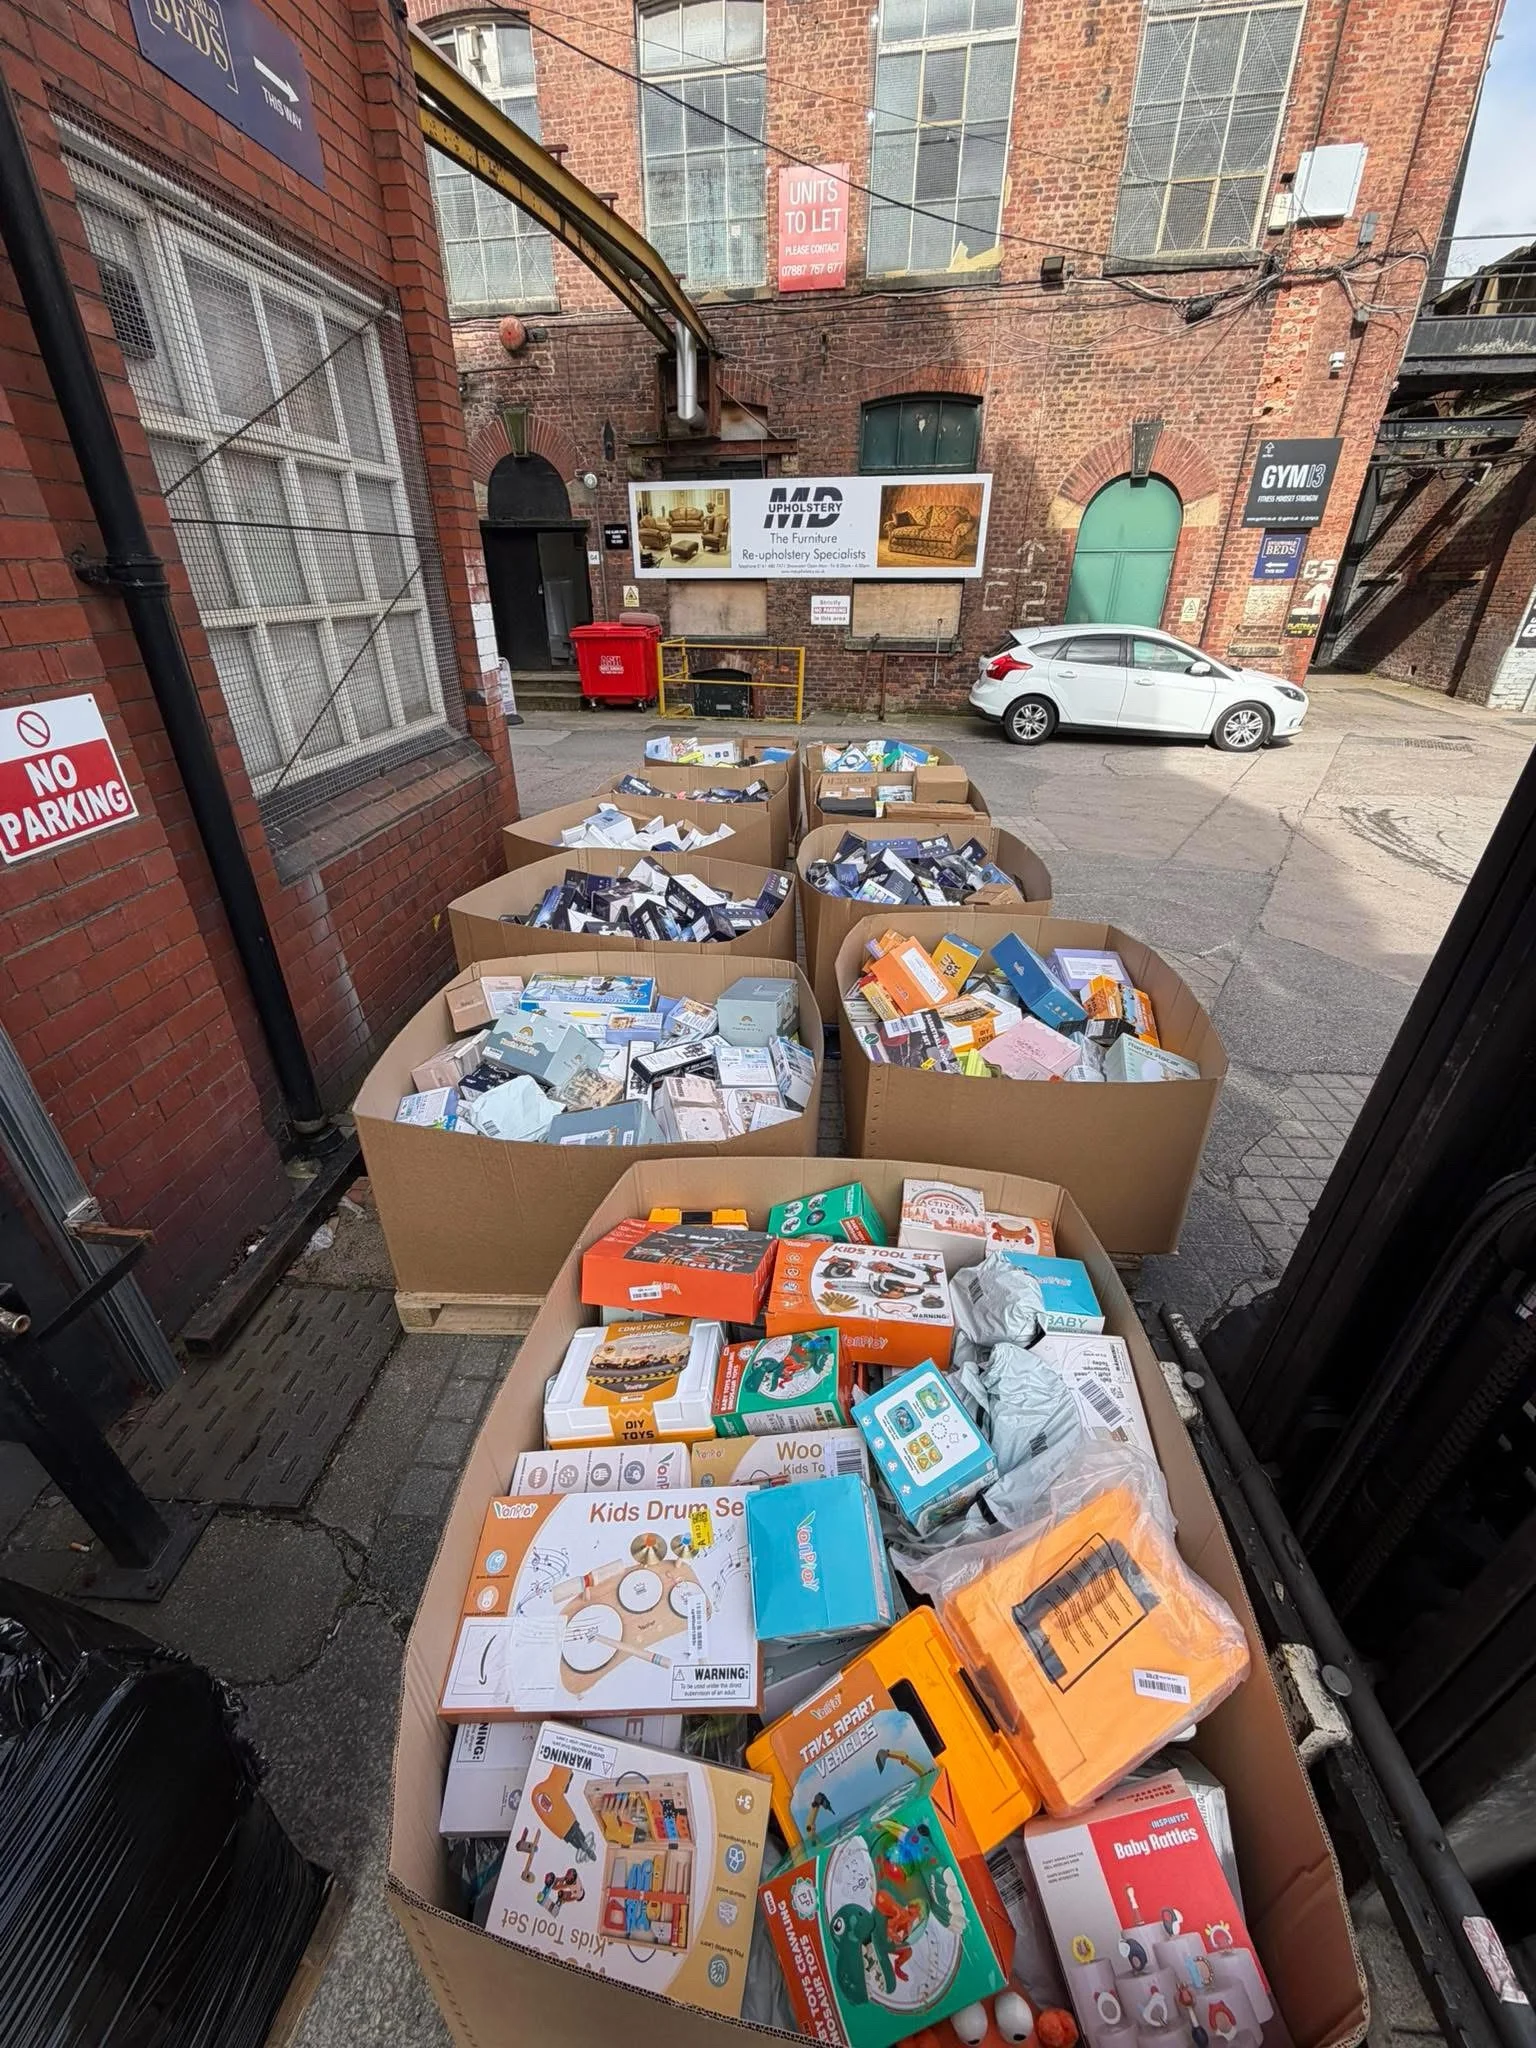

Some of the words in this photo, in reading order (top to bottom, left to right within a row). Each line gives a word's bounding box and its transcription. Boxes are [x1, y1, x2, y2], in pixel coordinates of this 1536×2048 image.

[261, 85, 285, 117] THIS
[283, 104, 302, 132] WAY
[789, 179, 838, 205] UNITS
[785, 211, 806, 234] TO
[812, 208, 842, 232] LET
[785, 244, 810, 256] PLEASE
[811, 243, 840, 254] CONTACT
[1261, 464, 1326, 488] GYM13
[764, 487, 843, 528] MD
[768, 503, 842, 513] UPHOLSTERY
[1257, 495, 1275, 503] FITNESS
[1295, 494, 1319, 502] STRENGTH
[770, 533, 788, 544] The
[792, 532, 837, 544] Furniture
[1266, 545, 1296, 555] BEDS
[742, 549, 810, 562] Re-upholstery
[814, 548, 866, 562] Specialists
[24, 754, 78, 797] NO
[0, 781, 128, 849] PARKING
[832, 1245, 867, 1254] KIDS
[870, 1247, 907, 1259] TOOL
[911, 1252, 942, 1261] SET
[618, 1321, 685, 1332] CONSTRUCTION
[1047, 1315, 1088, 1328] BABY
[723, 1379, 731, 1394] TOYS
[621, 1430, 655, 1441] TOYS
[625, 1420, 645, 1429] DIY
[783, 1463, 809, 1475] Kids
[589, 1501, 640, 1524] Kids
[646, 1500, 709, 1521] Drum
[715, 1496, 745, 1518] Se
[694, 1667, 749, 1681] WARNING:
[799, 1727, 835, 1764] TAKE
[833, 1694, 876, 1739] APART
[540, 1745, 592, 1771] WARNING:
[815, 1721, 878, 1779] VEHICLES
[736, 1794, 752, 1809] 3+
[1113, 1838, 1151, 1860] Baby
[1149, 1827, 1199, 1850] Rattles
[501, 1909, 530, 1934] Set
[531, 1917, 565, 1945] Tool
[570, 1929, 606, 1958] Kids
[777, 1900, 807, 1974] CRAWLING
[800, 1934, 818, 1976] TOYS
[801, 1978, 820, 2018] TOYS
